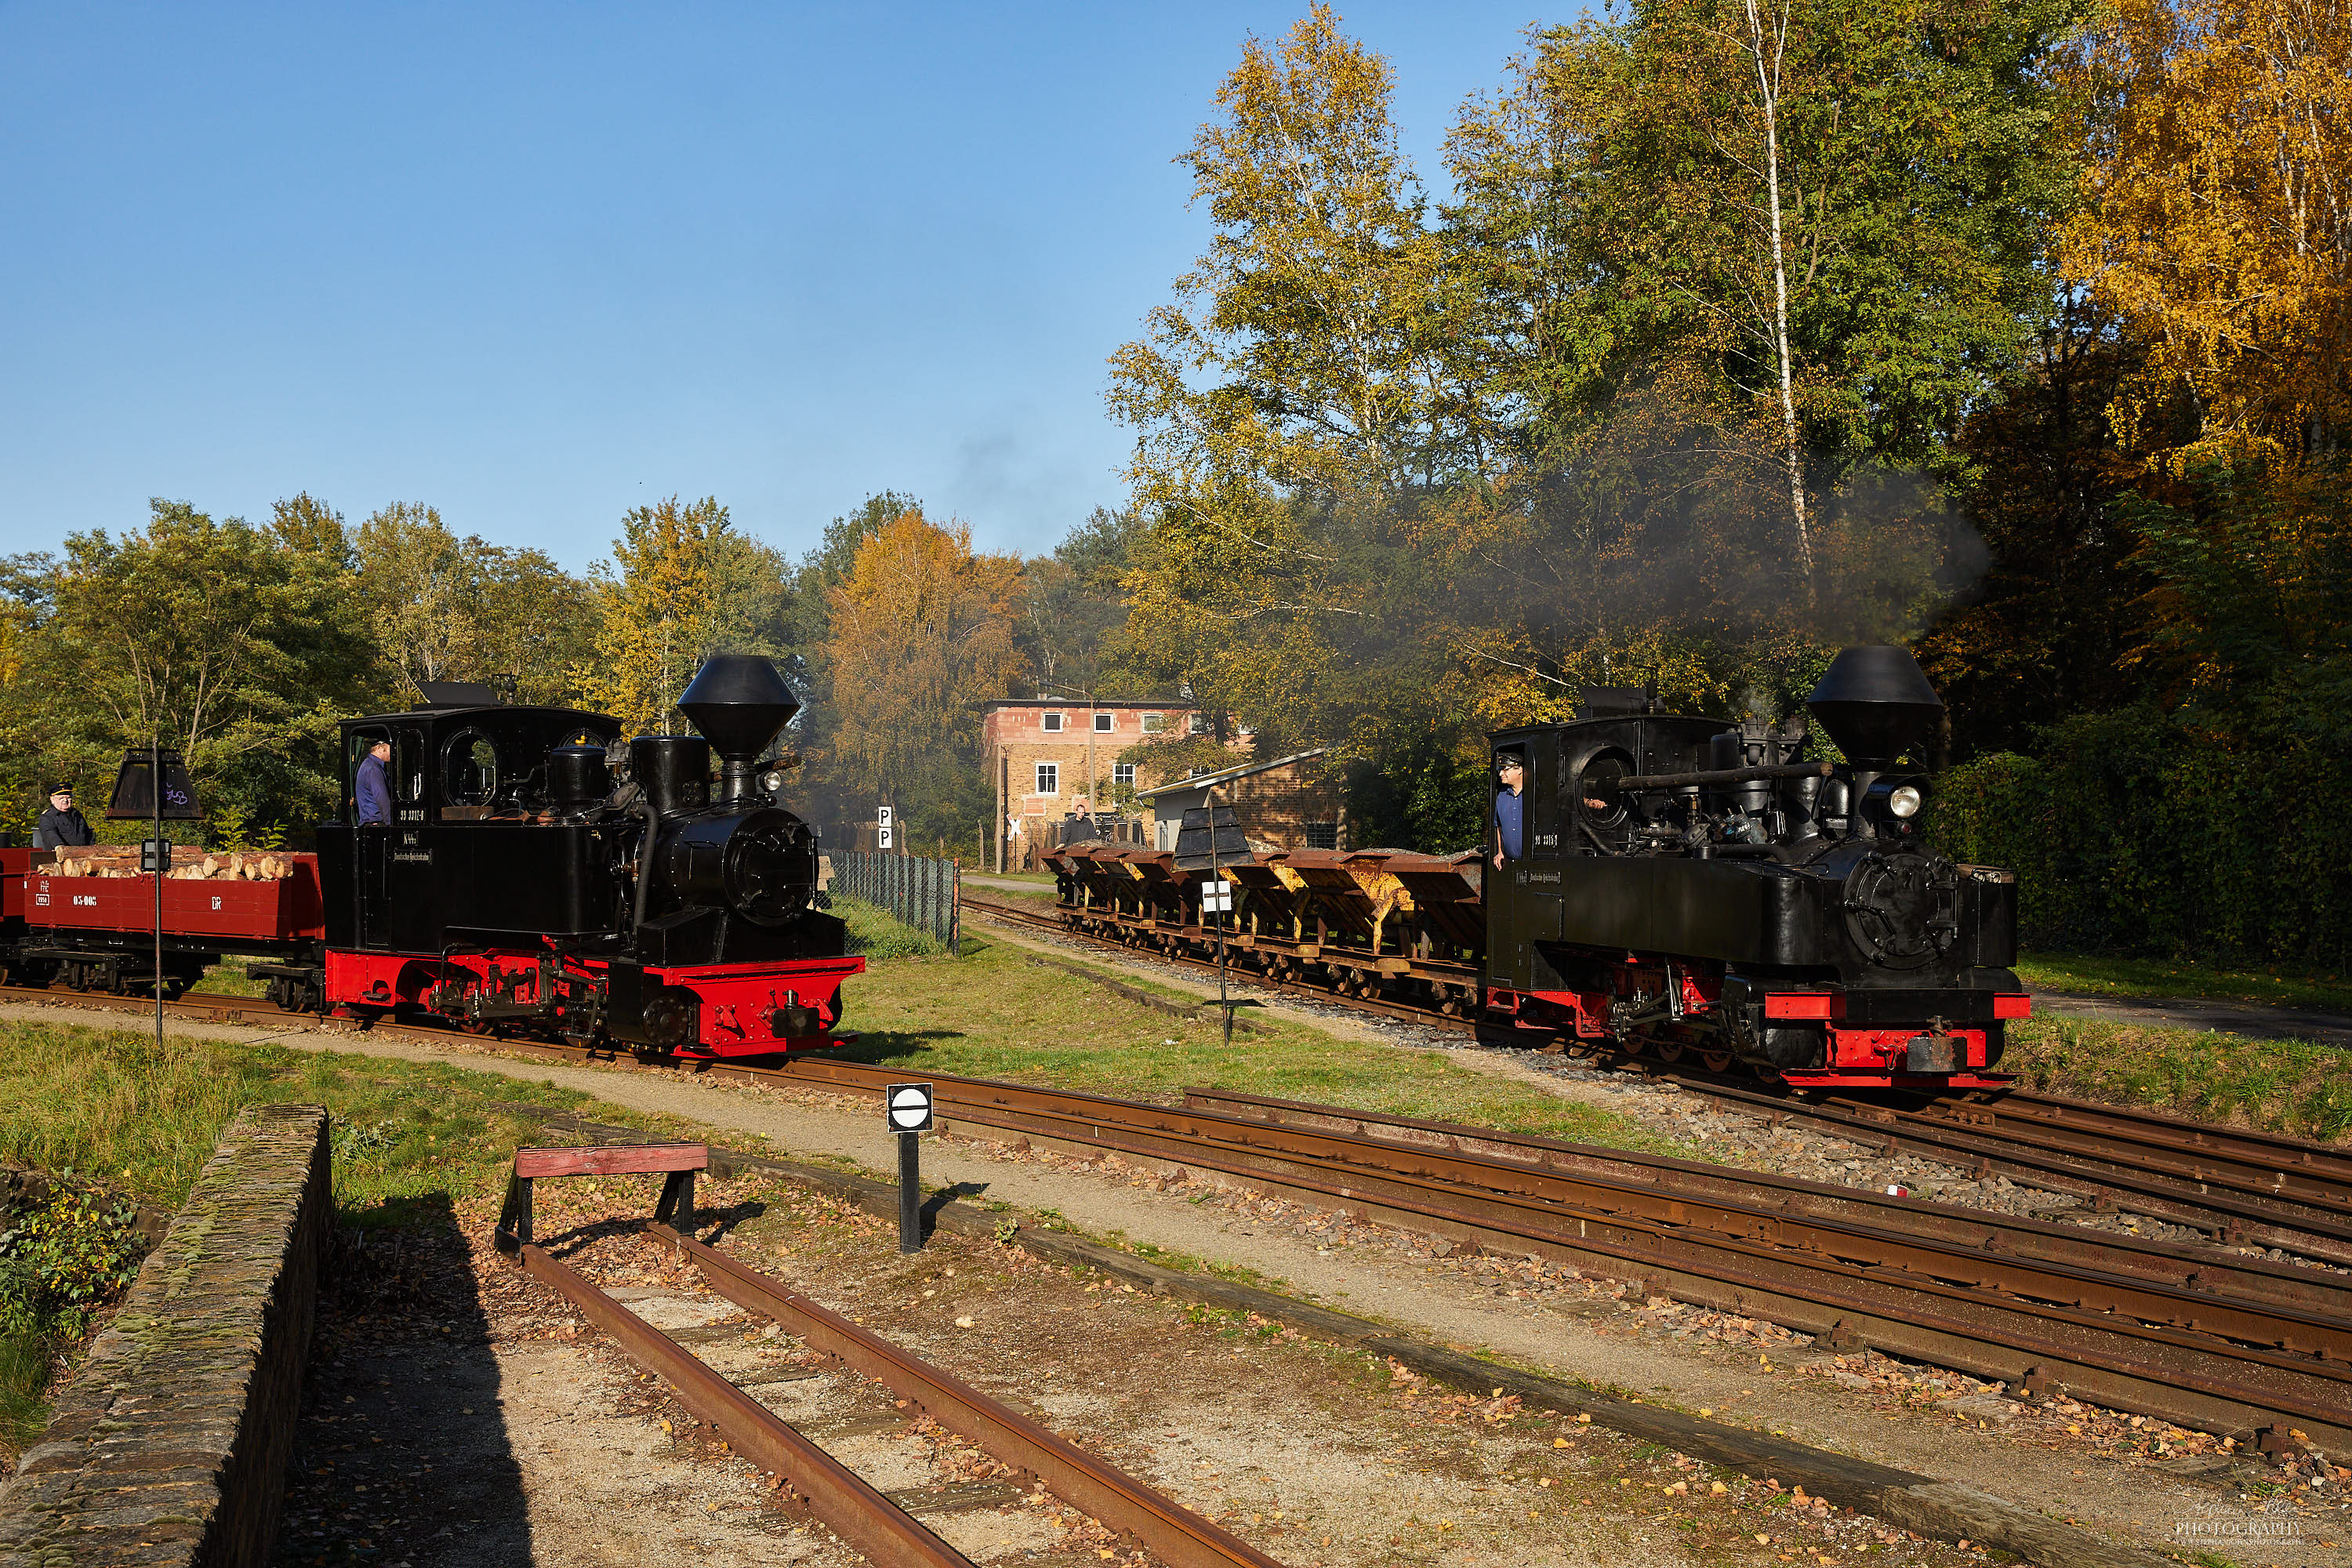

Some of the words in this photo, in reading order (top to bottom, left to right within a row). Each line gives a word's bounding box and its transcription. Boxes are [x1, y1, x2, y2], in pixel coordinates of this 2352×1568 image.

[401, 810, 406, 821] 99
[880, 810, 888, 823] P
[881, 831, 889, 844] P
[212, 896, 222, 910] DR
